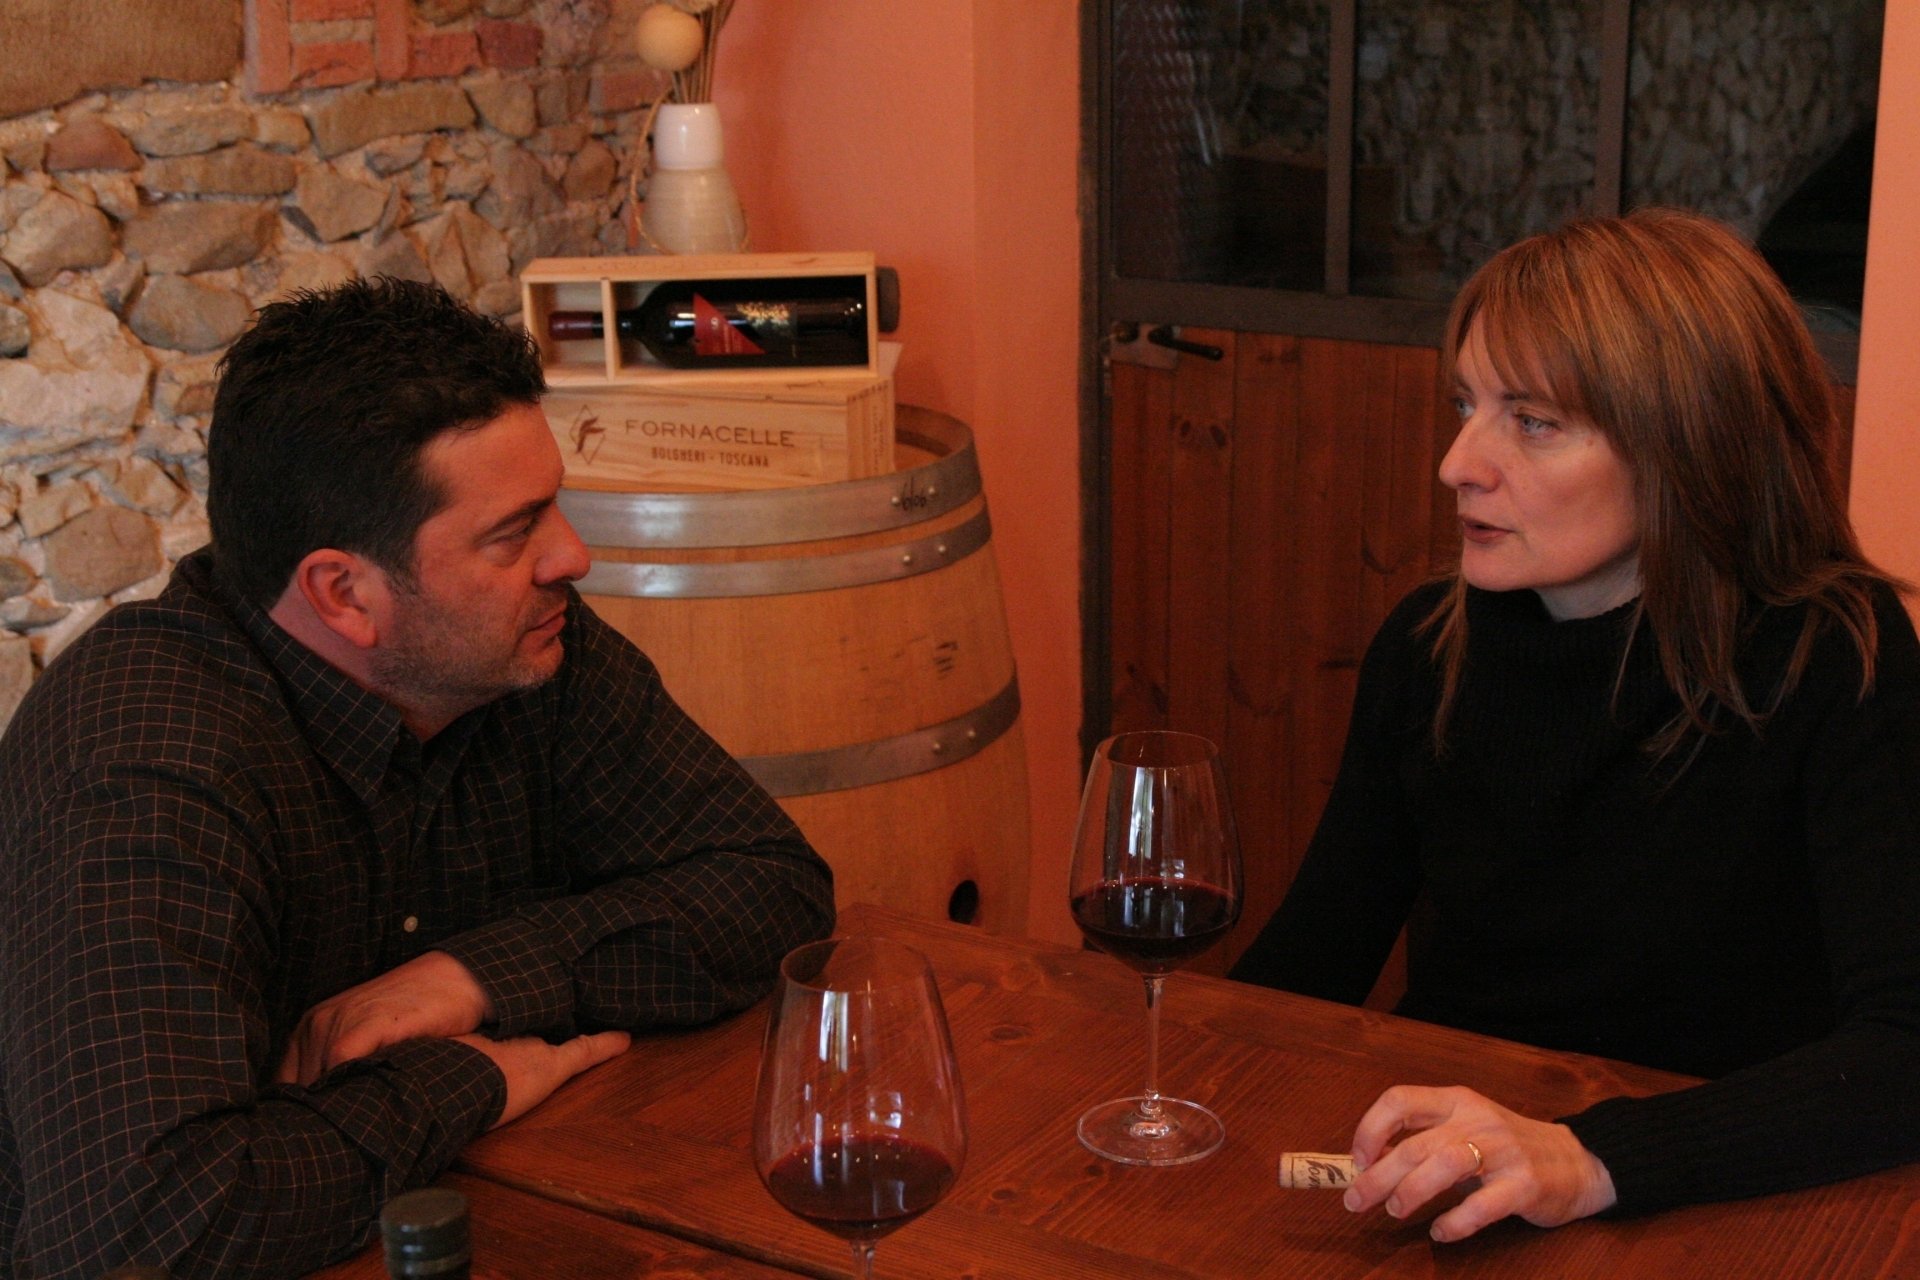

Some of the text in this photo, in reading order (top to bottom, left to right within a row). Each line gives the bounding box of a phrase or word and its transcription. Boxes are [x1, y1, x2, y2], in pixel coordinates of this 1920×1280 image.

[625, 419, 795, 447] FORNACELLE
[651, 446, 705, 463] BOLGHERI
[720, 451, 769, 468] TOSCANA
